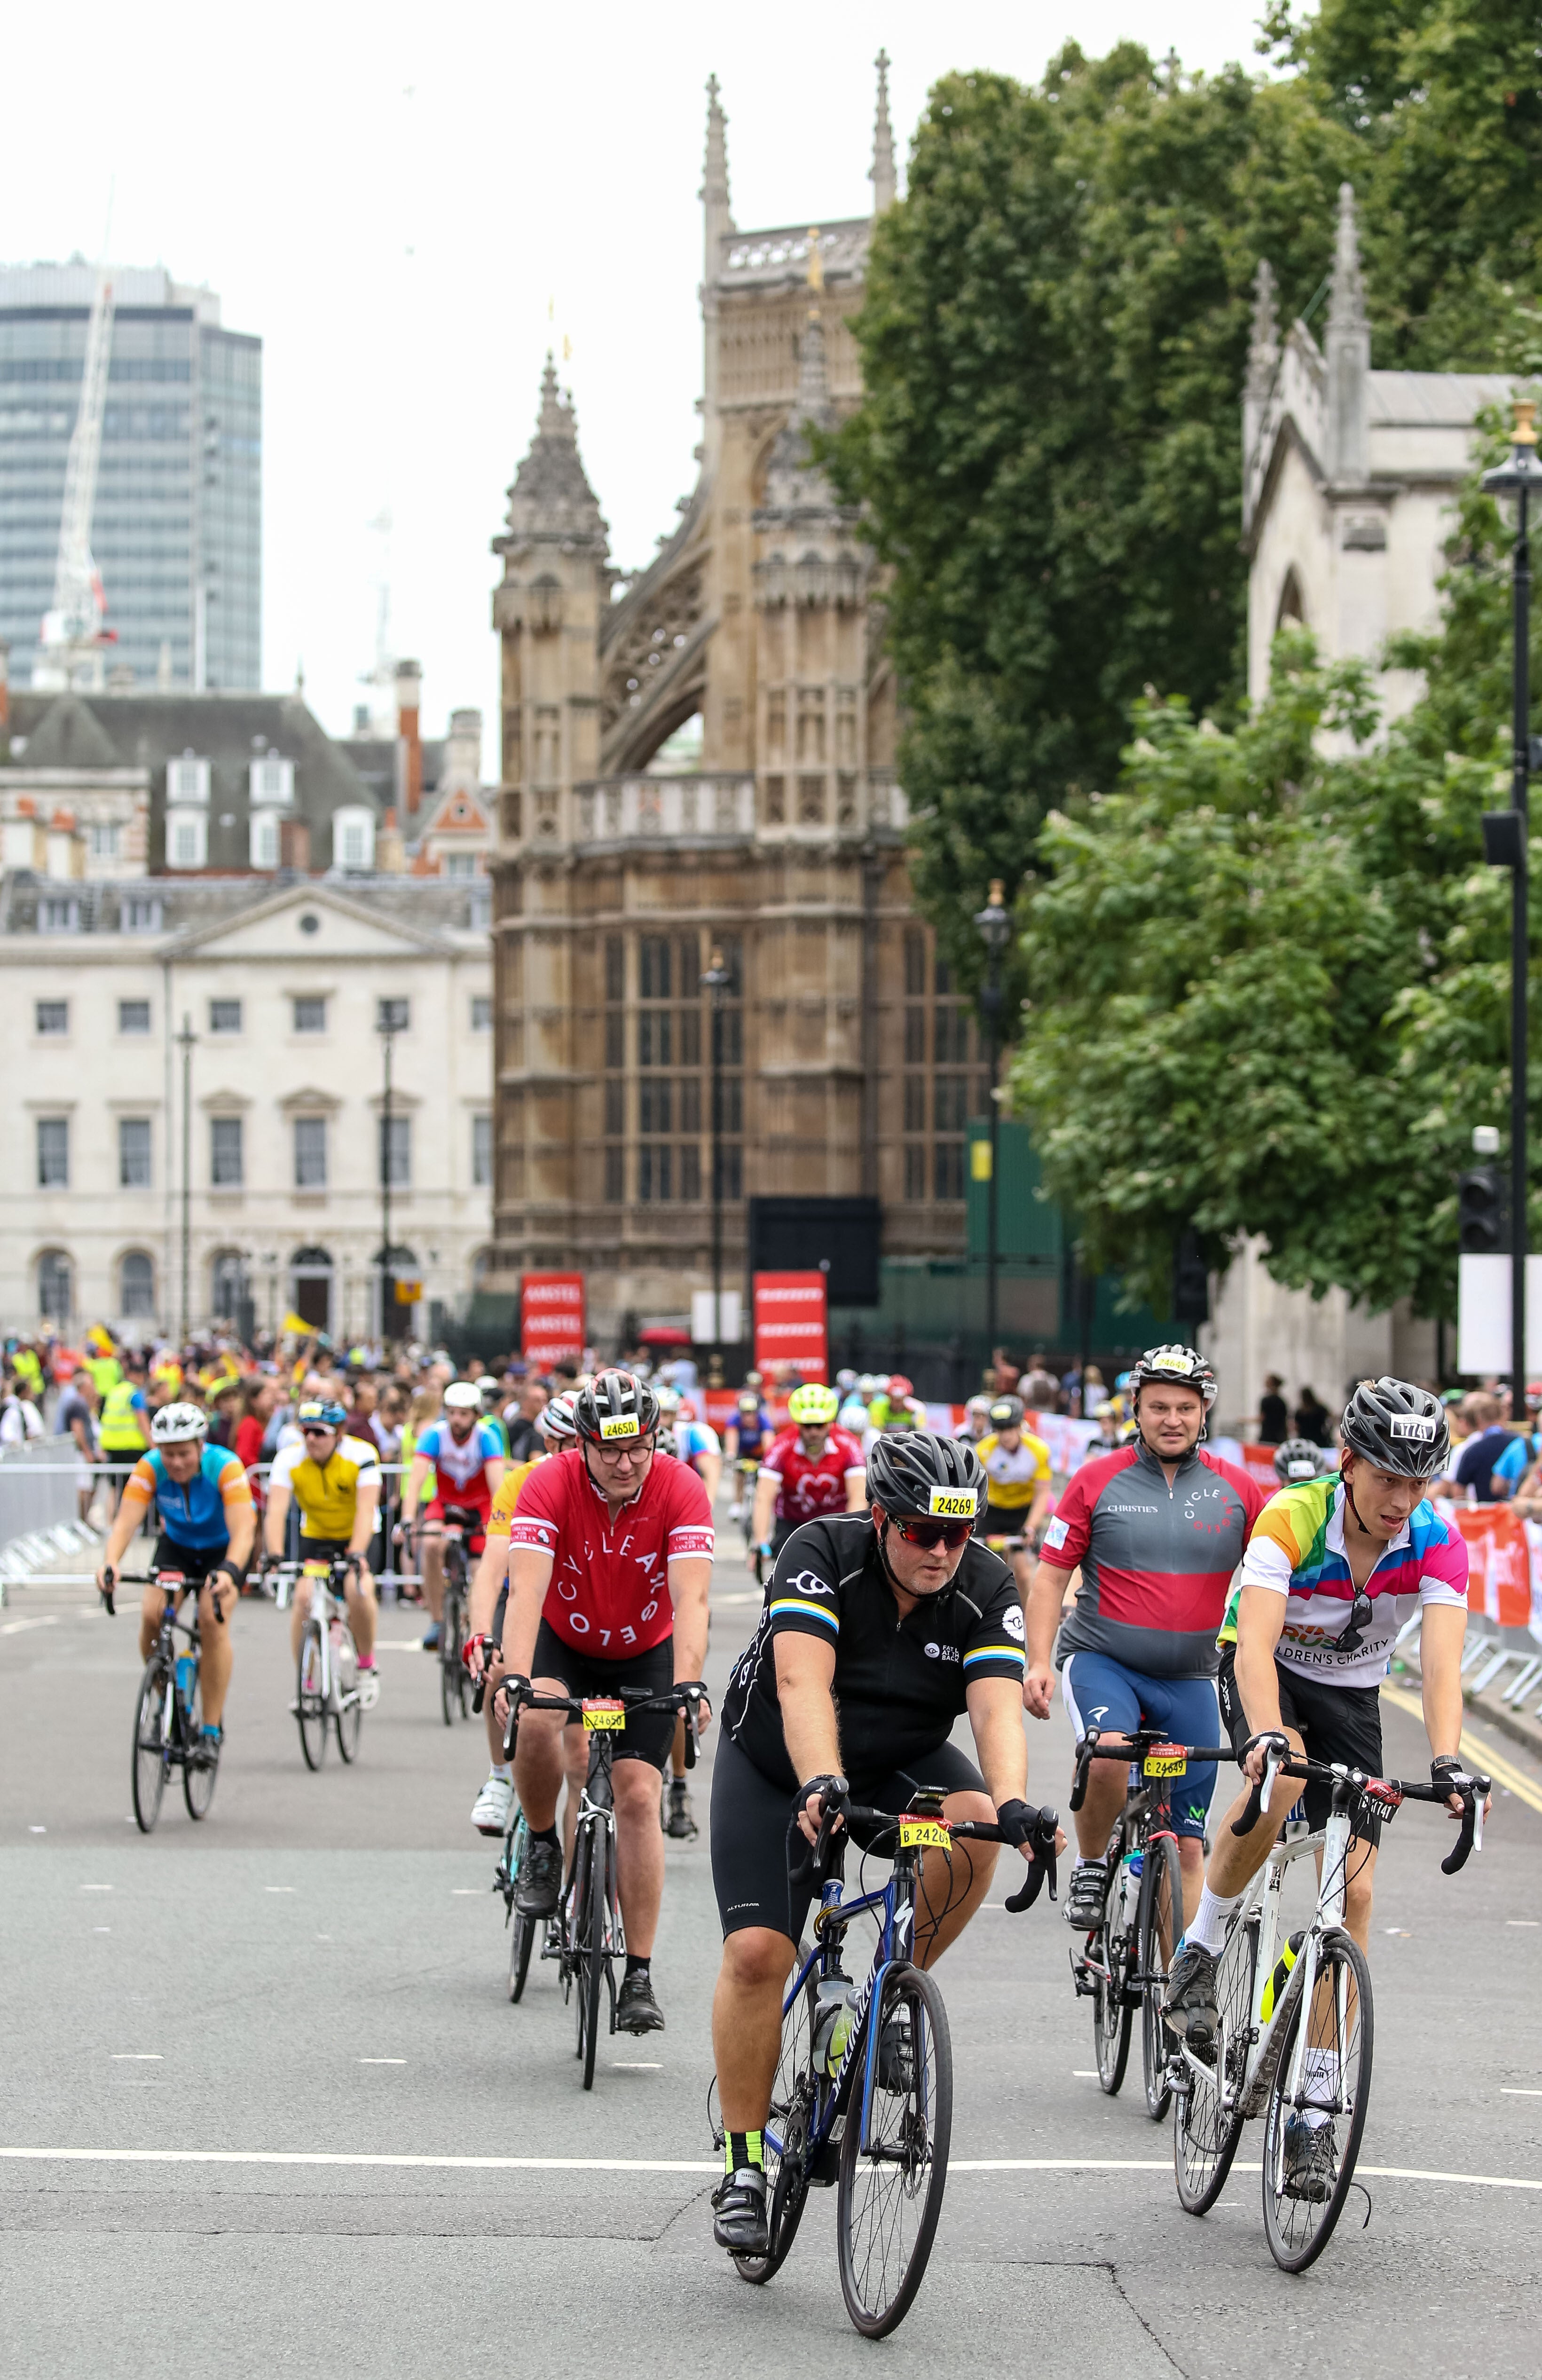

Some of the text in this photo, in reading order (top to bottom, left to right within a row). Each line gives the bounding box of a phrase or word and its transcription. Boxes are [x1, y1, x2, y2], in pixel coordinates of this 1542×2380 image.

[1158, 1359, 1186, 1370] 24649
[607, 1422, 634, 1435] 24650
[1400, 1423, 1427, 1439] 17741
[937, 1497, 971, 1514] 24269
[1184, 1488, 1220, 1520] CYCLE
[1276, 1639, 1389, 1665] LDREN'S CHARITY
[594, 1715, 622, 1725] 24650
[1147, 1762, 1183, 1773] C 24649
[904, 1828, 948, 1844] B 24269
[727, 1903, 755, 1912] ALTURA
[1269, 2088, 1280, 2134] GIANT
